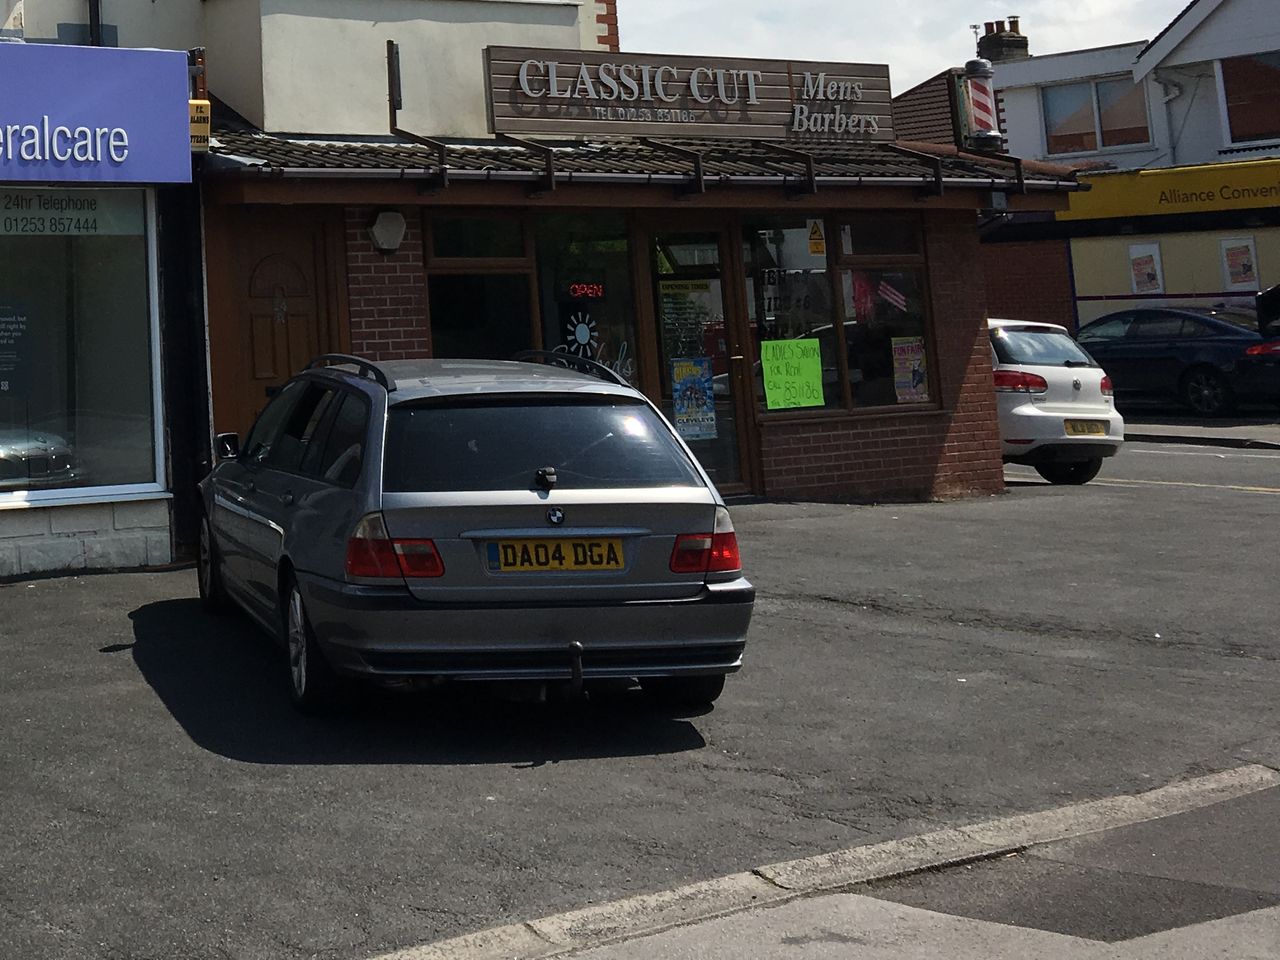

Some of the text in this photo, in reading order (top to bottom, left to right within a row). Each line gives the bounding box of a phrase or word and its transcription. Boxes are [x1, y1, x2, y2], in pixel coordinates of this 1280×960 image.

[519, 59, 762, 106] CLASSIC CUT
[618, 107, 652, 122] 01253
[656, 108, 696, 123] 851186
[791, 103, 880, 136] Barbers
[4, 193, 98, 213] 24hr Telephone
[1158, 188, 1215, 205] Alliance
[4, 216, 99, 233] 01253 857444
[568, 283, 605, 298] OPEN
[501, 542, 566, 567] DA04
[572, 542, 621, 567] DGA
